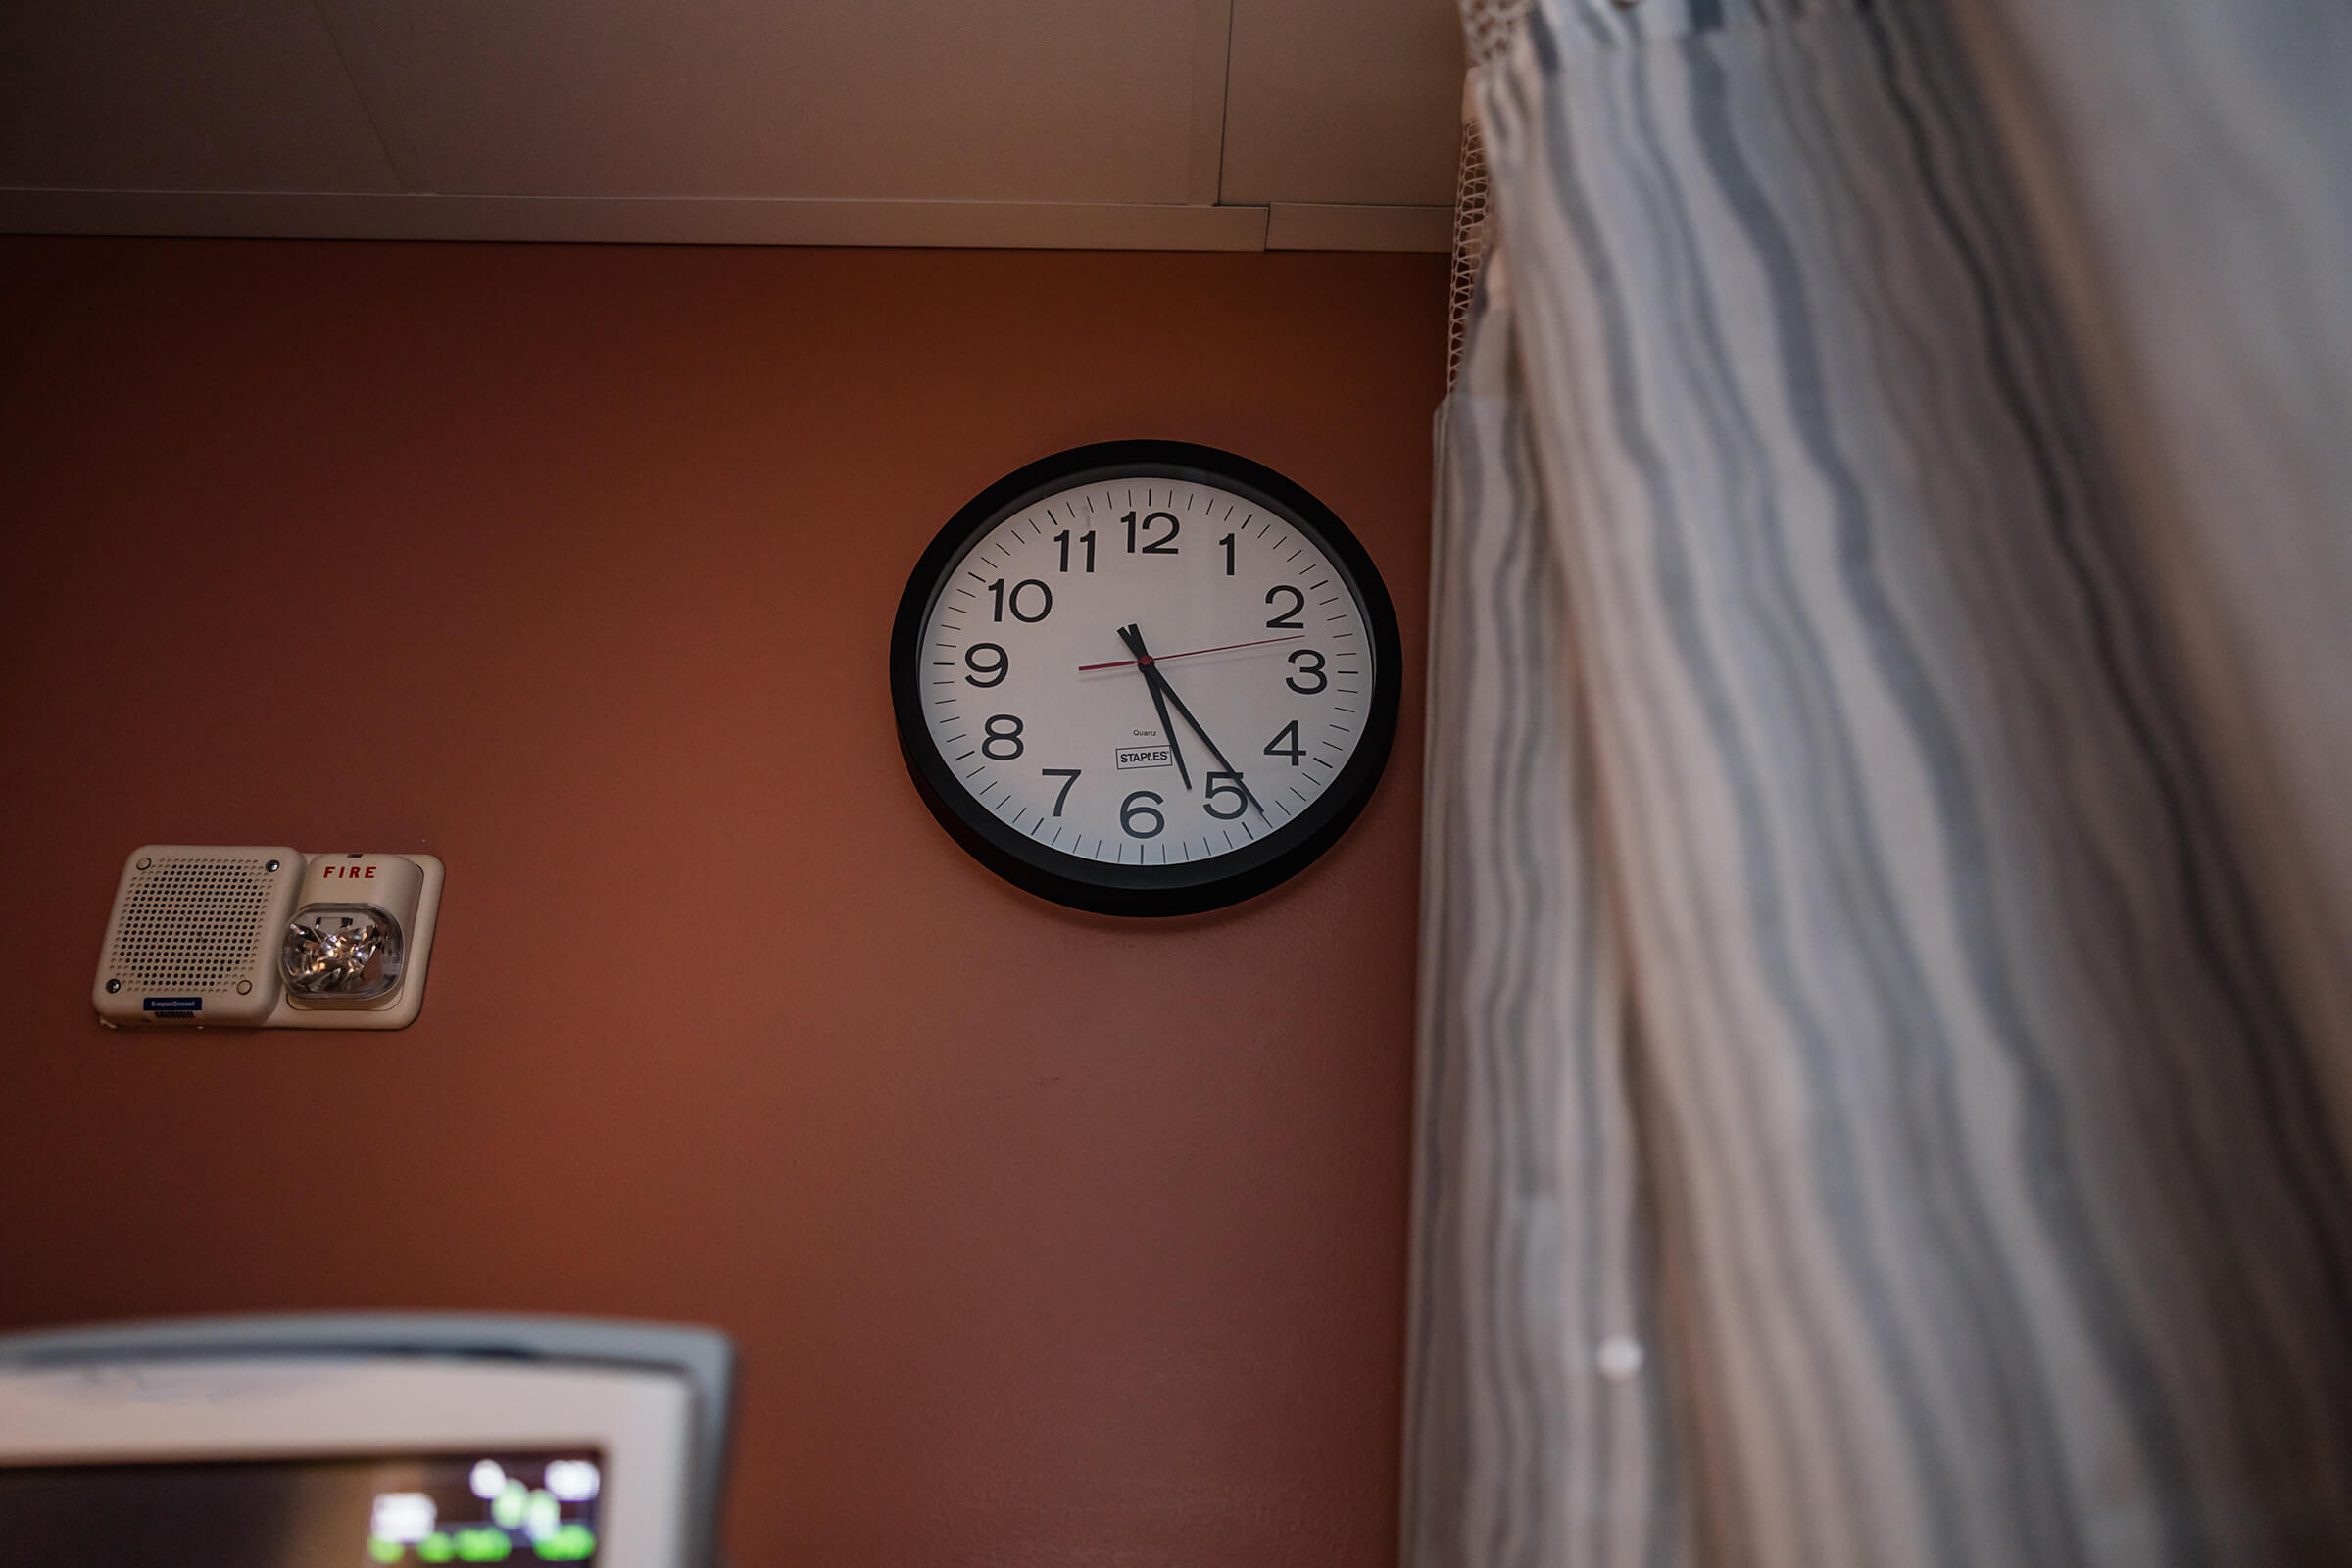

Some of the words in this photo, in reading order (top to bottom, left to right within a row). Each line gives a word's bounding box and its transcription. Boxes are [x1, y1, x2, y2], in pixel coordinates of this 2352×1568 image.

[1054, 529, 1097, 572] 11
[1121, 511, 1180, 554] 12
[1218, 532, 1236, 576] 1
[988, 578, 1053, 623] 10
[1265, 585, 1305, 629] 2
[964, 643, 1008, 688] 9
[1285, 649, 1327, 695] 3
[981, 714, 1024, 760] 8
[1120, 751, 1168, 763] STAPLES
[1263, 719, 1306, 766] 4
[1042, 768, 1081, 817] 7
[1202, 771, 1249, 821] 5
[1119, 791, 1165, 840] 6
[323, 865, 377, 879] FIRE
